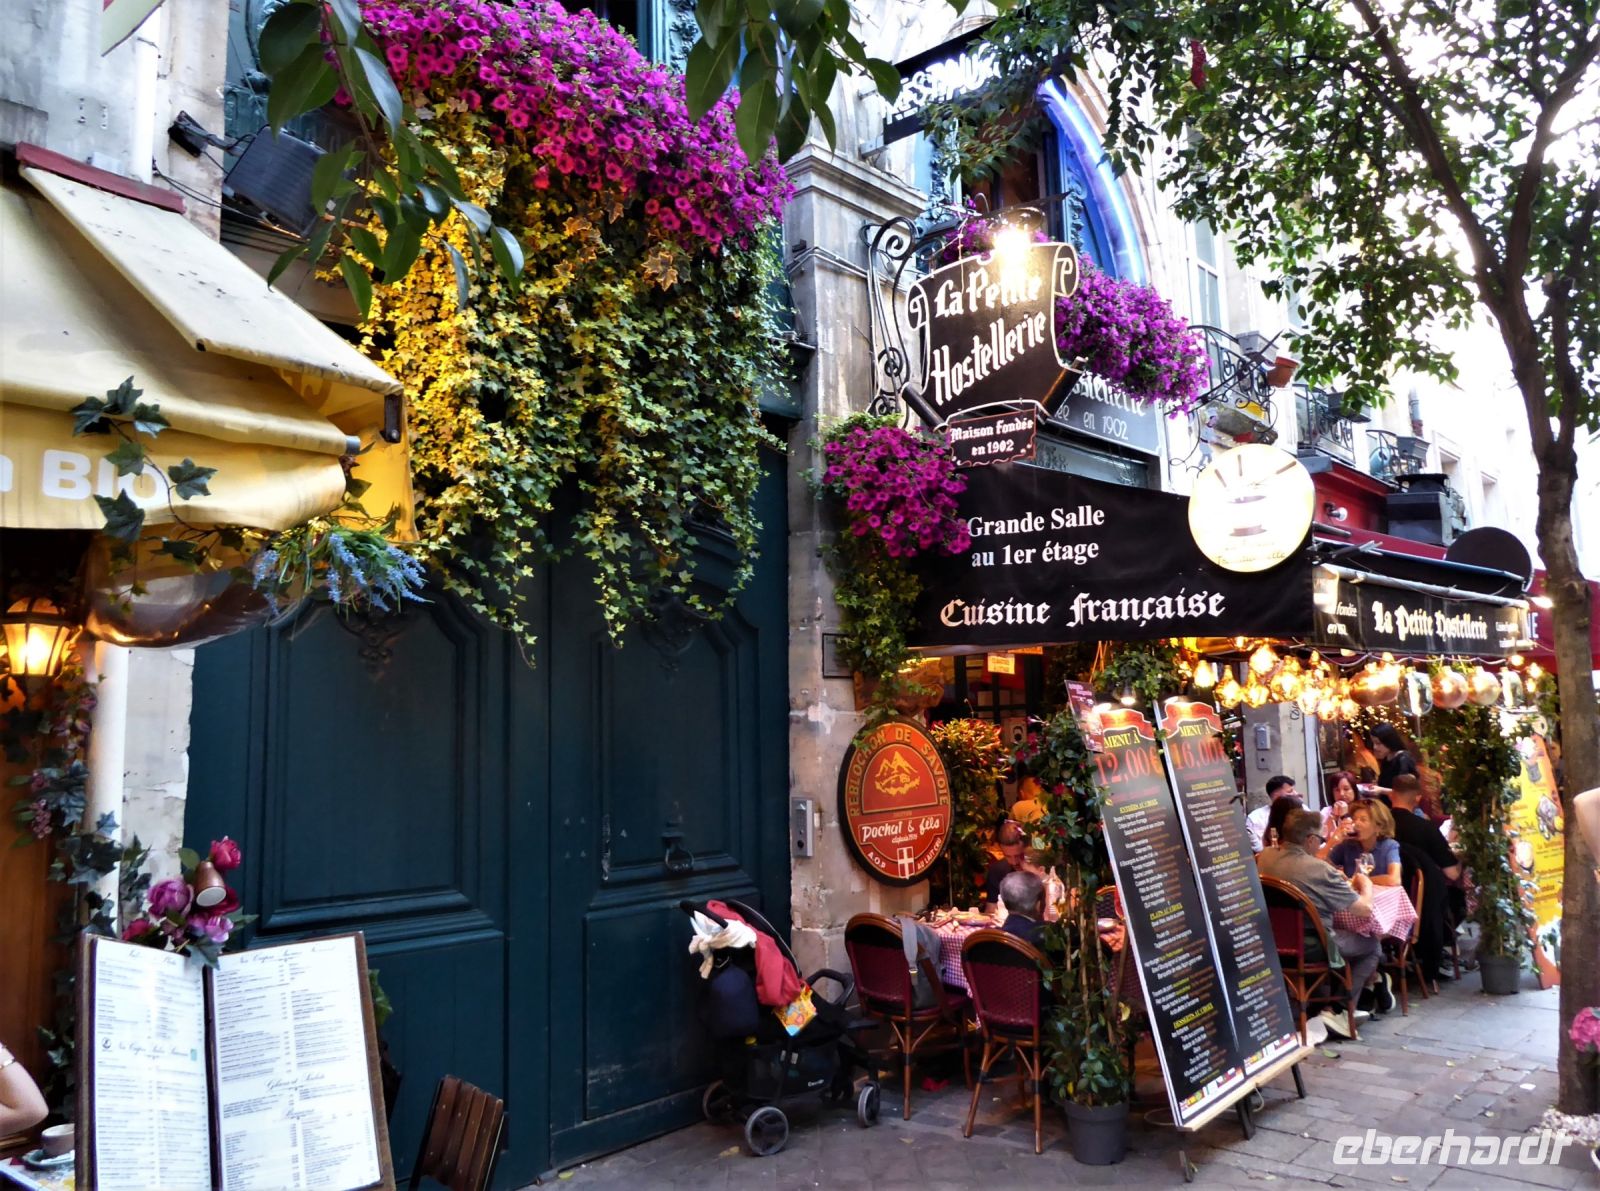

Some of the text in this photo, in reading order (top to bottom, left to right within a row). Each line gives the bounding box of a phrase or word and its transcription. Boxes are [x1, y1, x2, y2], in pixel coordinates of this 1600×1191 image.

[933, 279, 964, 317] La
[930, 311, 1047, 406] Hostellerie
[951, 425, 994, 443] Maison
[1083, 411, 1096, 430] en
[1102, 416, 1129, 440] 1902
[971, 439, 1014, 457] en 1902
[967, 505, 1105, 537] Grande Salle
[971, 541, 1099, 567] au 1er étage
[940, 598, 1050, 628] Cuisine
[1372, 601, 1394, 633] La
[1394, 605, 1433, 641] Petite
[1434, 610, 1488, 642] Hostellerie
[1103, 733, 1132, 749] MENU
[1180, 724, 1201, 737] MENU
[895, 727, 912, 742] DE
[921, 743, 950, 806] SAVOIE
[862, 816, 940, 842] Pochat & fils
[917, 861, 925, 870] AU
[925, 849, 935, 864] LAIT
